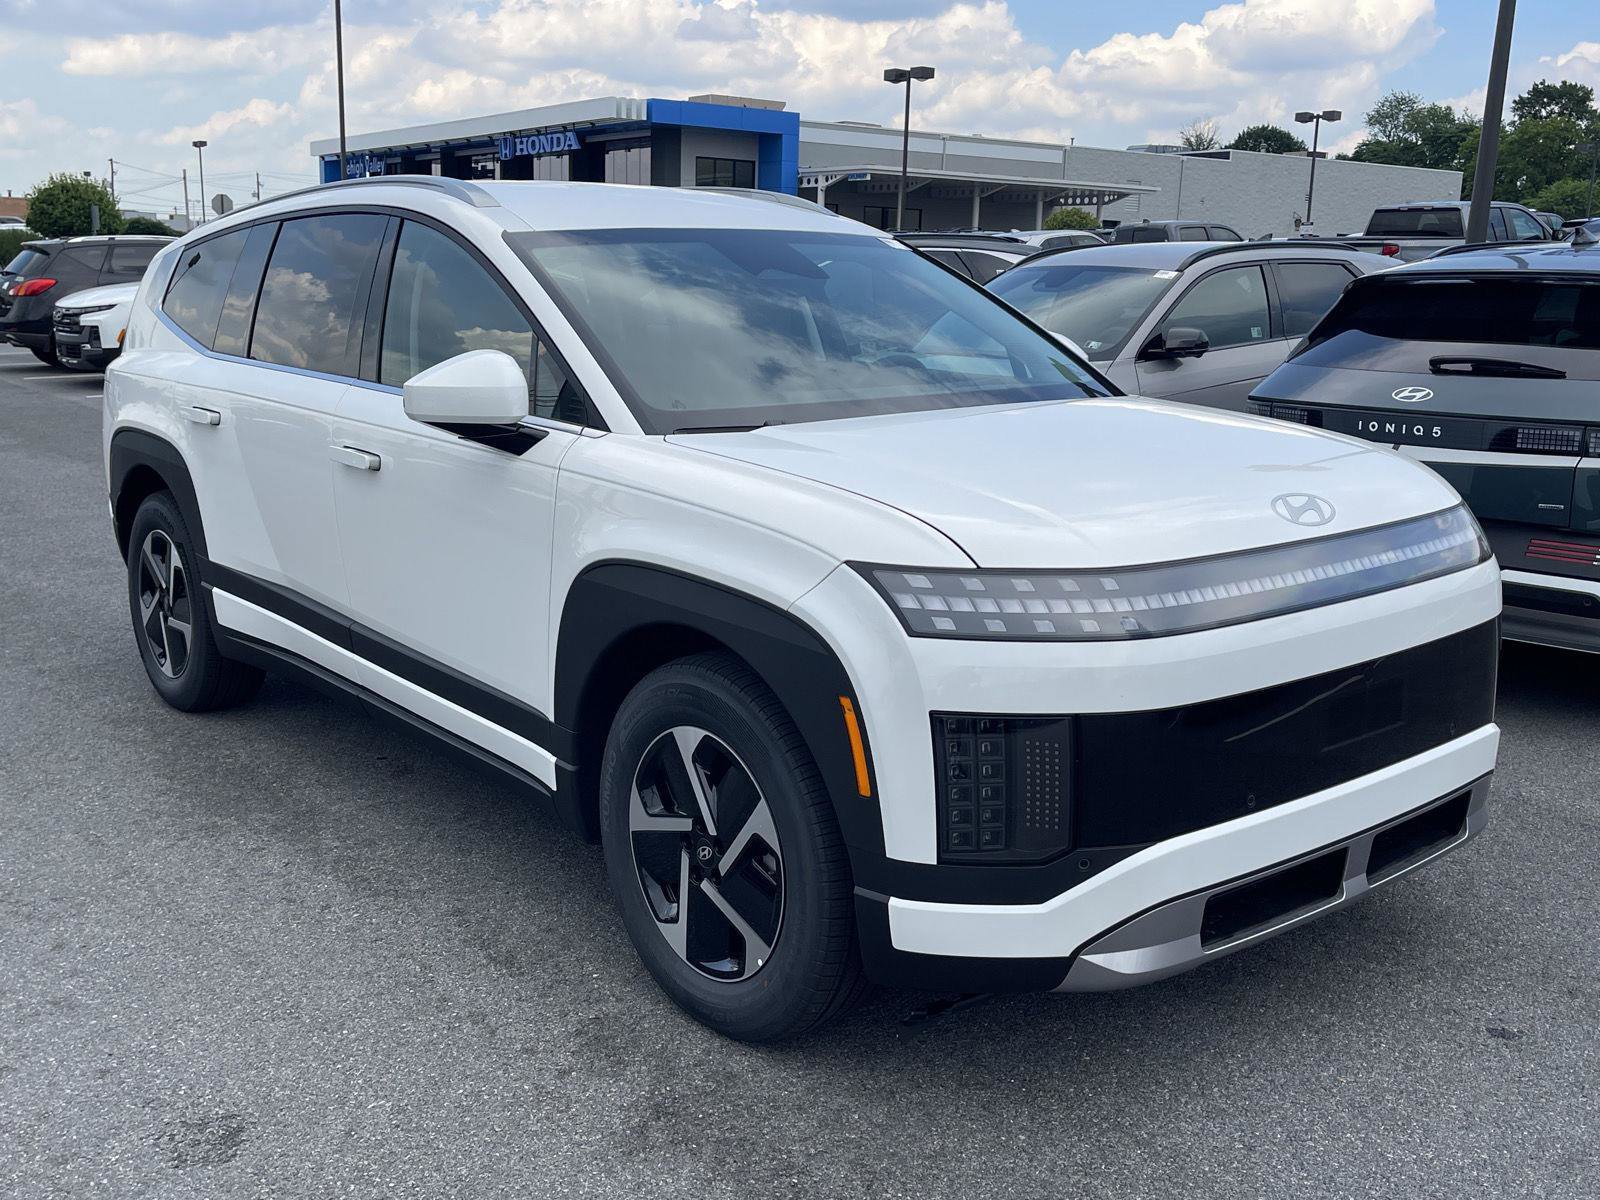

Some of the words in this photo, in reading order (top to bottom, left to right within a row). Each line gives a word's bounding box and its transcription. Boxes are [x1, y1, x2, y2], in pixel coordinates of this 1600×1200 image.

[515, 131, 581, 156] HONDA
[346, 158, 364, 178] ehigh
[1358, 420, 1424, 436] IONIQ
[1432, 426, 1442, 438] 5
